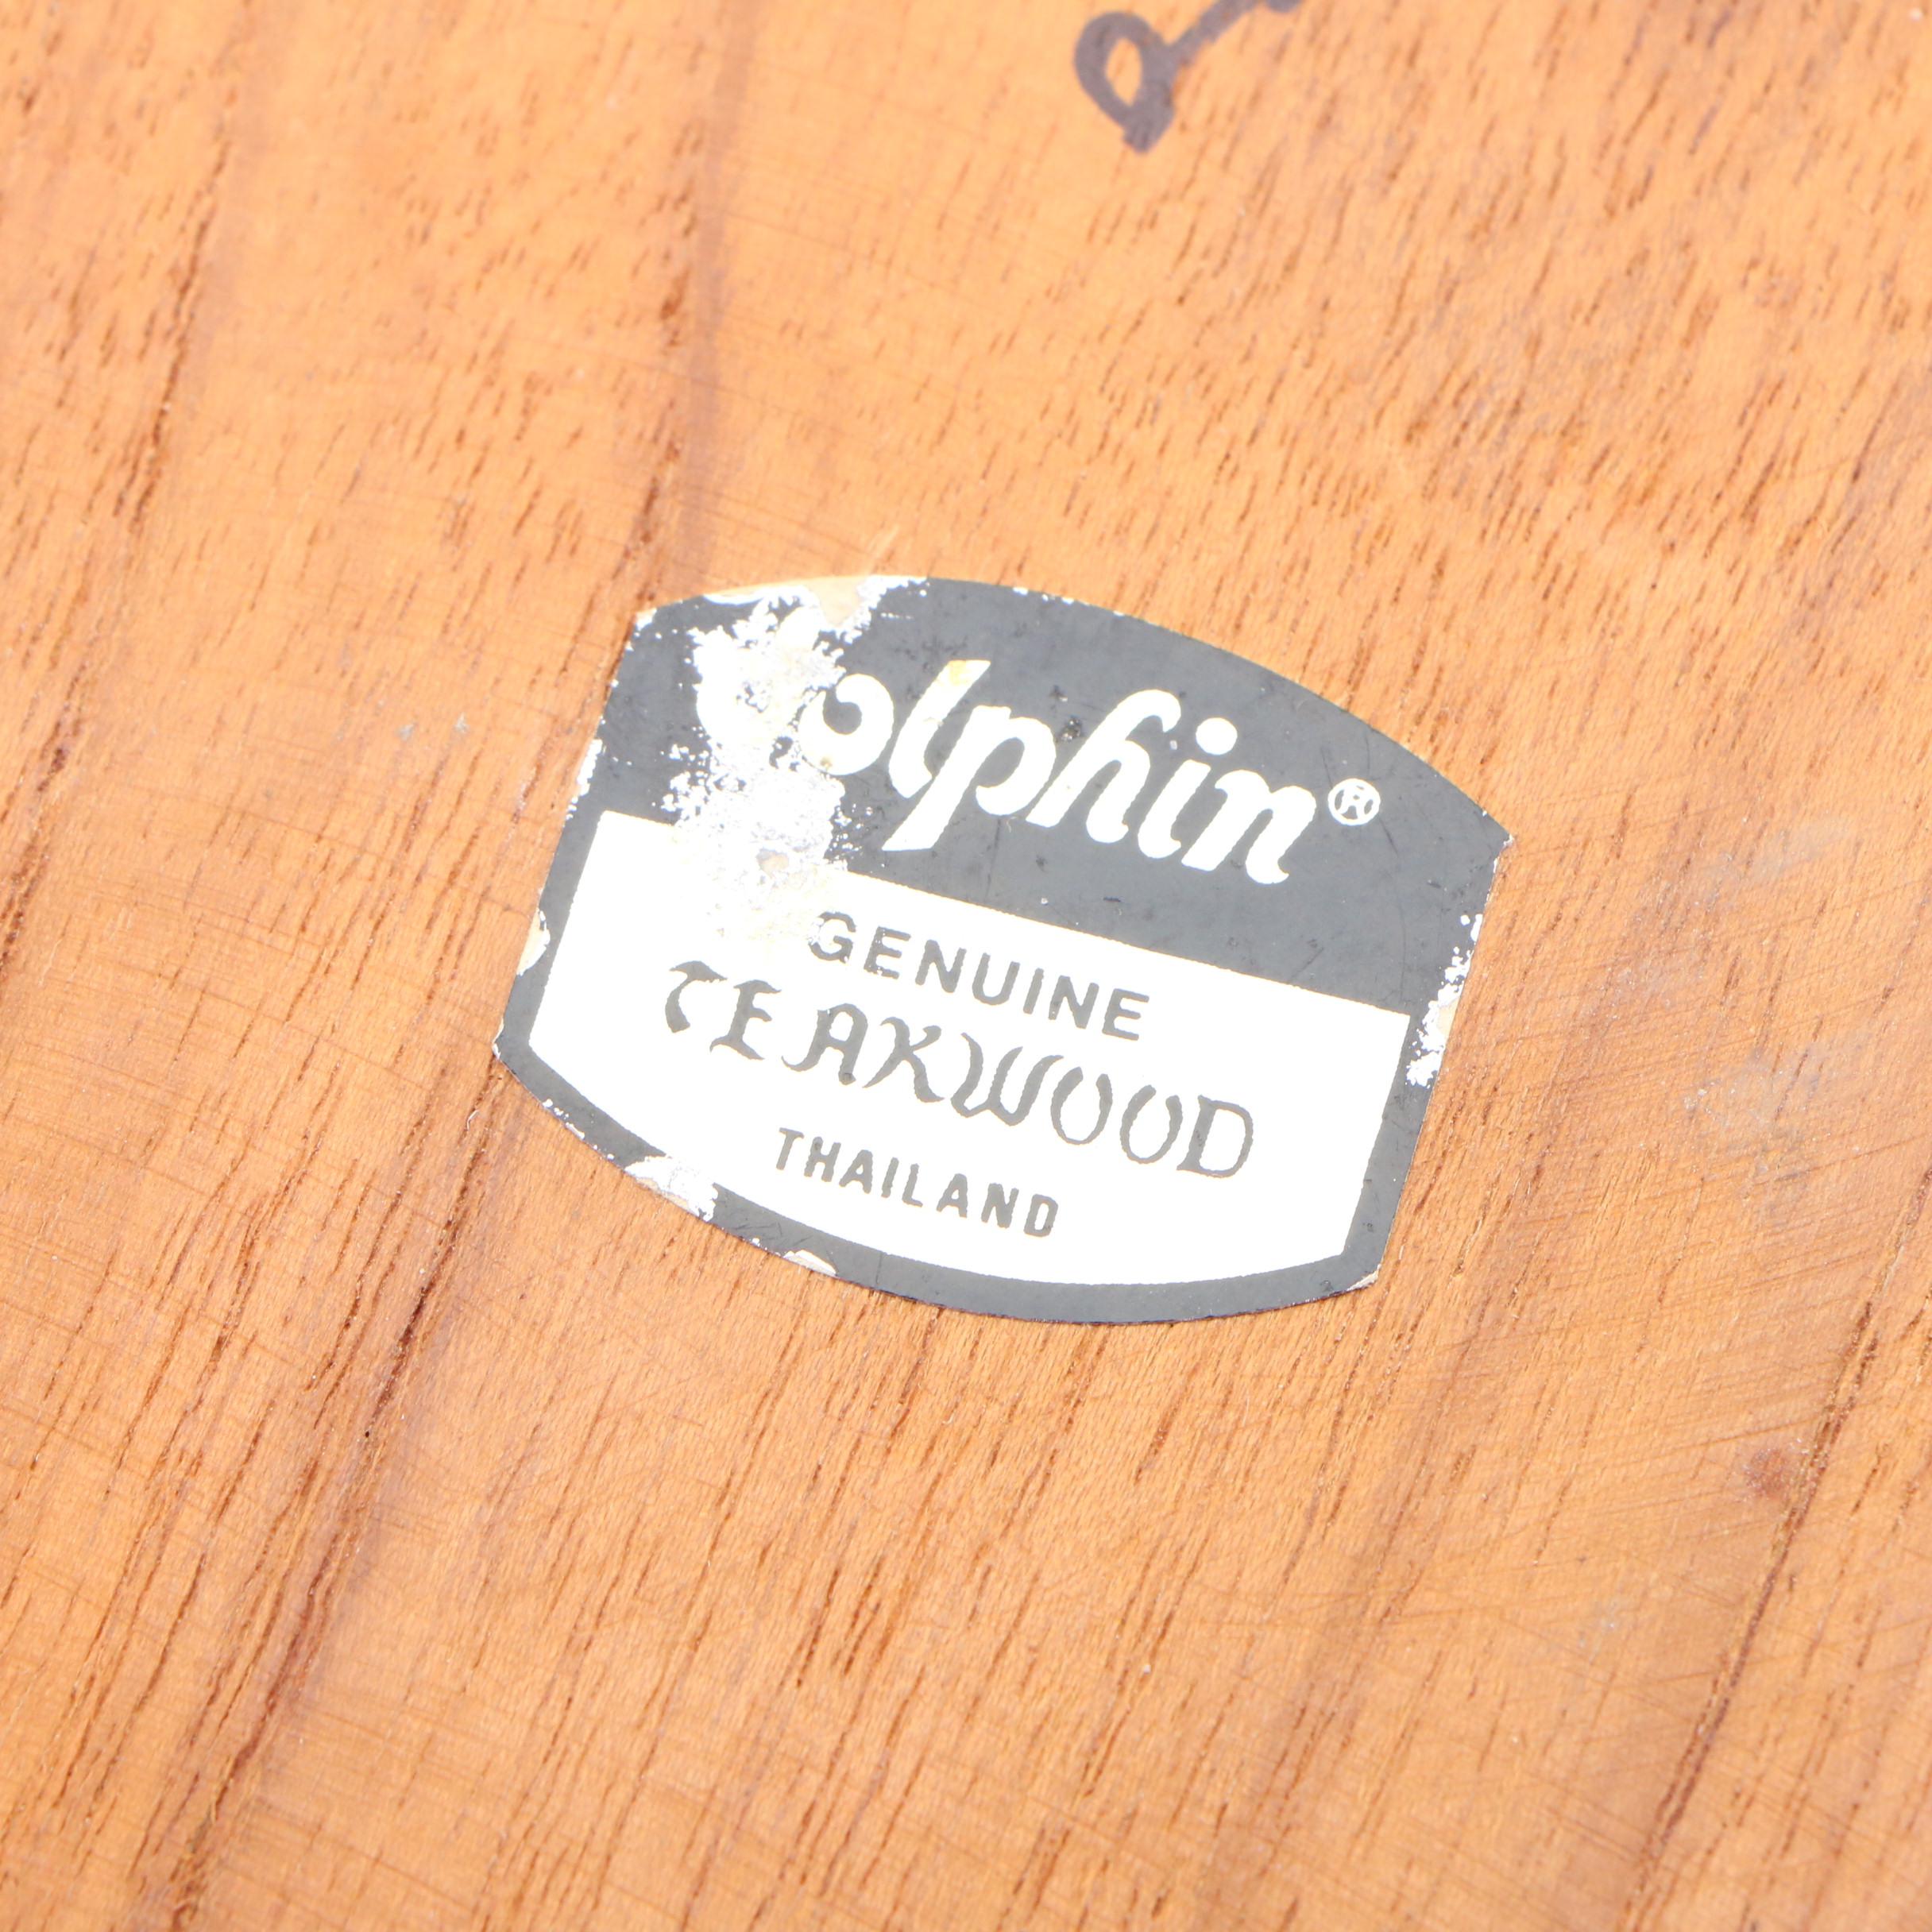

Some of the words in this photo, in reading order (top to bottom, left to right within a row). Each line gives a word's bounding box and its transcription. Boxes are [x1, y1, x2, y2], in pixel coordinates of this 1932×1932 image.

[809, 911, 1150, 1041] GENUINE
[664, 960, 1254, 1178] TEAKWOOD
[775, 1127, 1058, 1238] THAILAND
